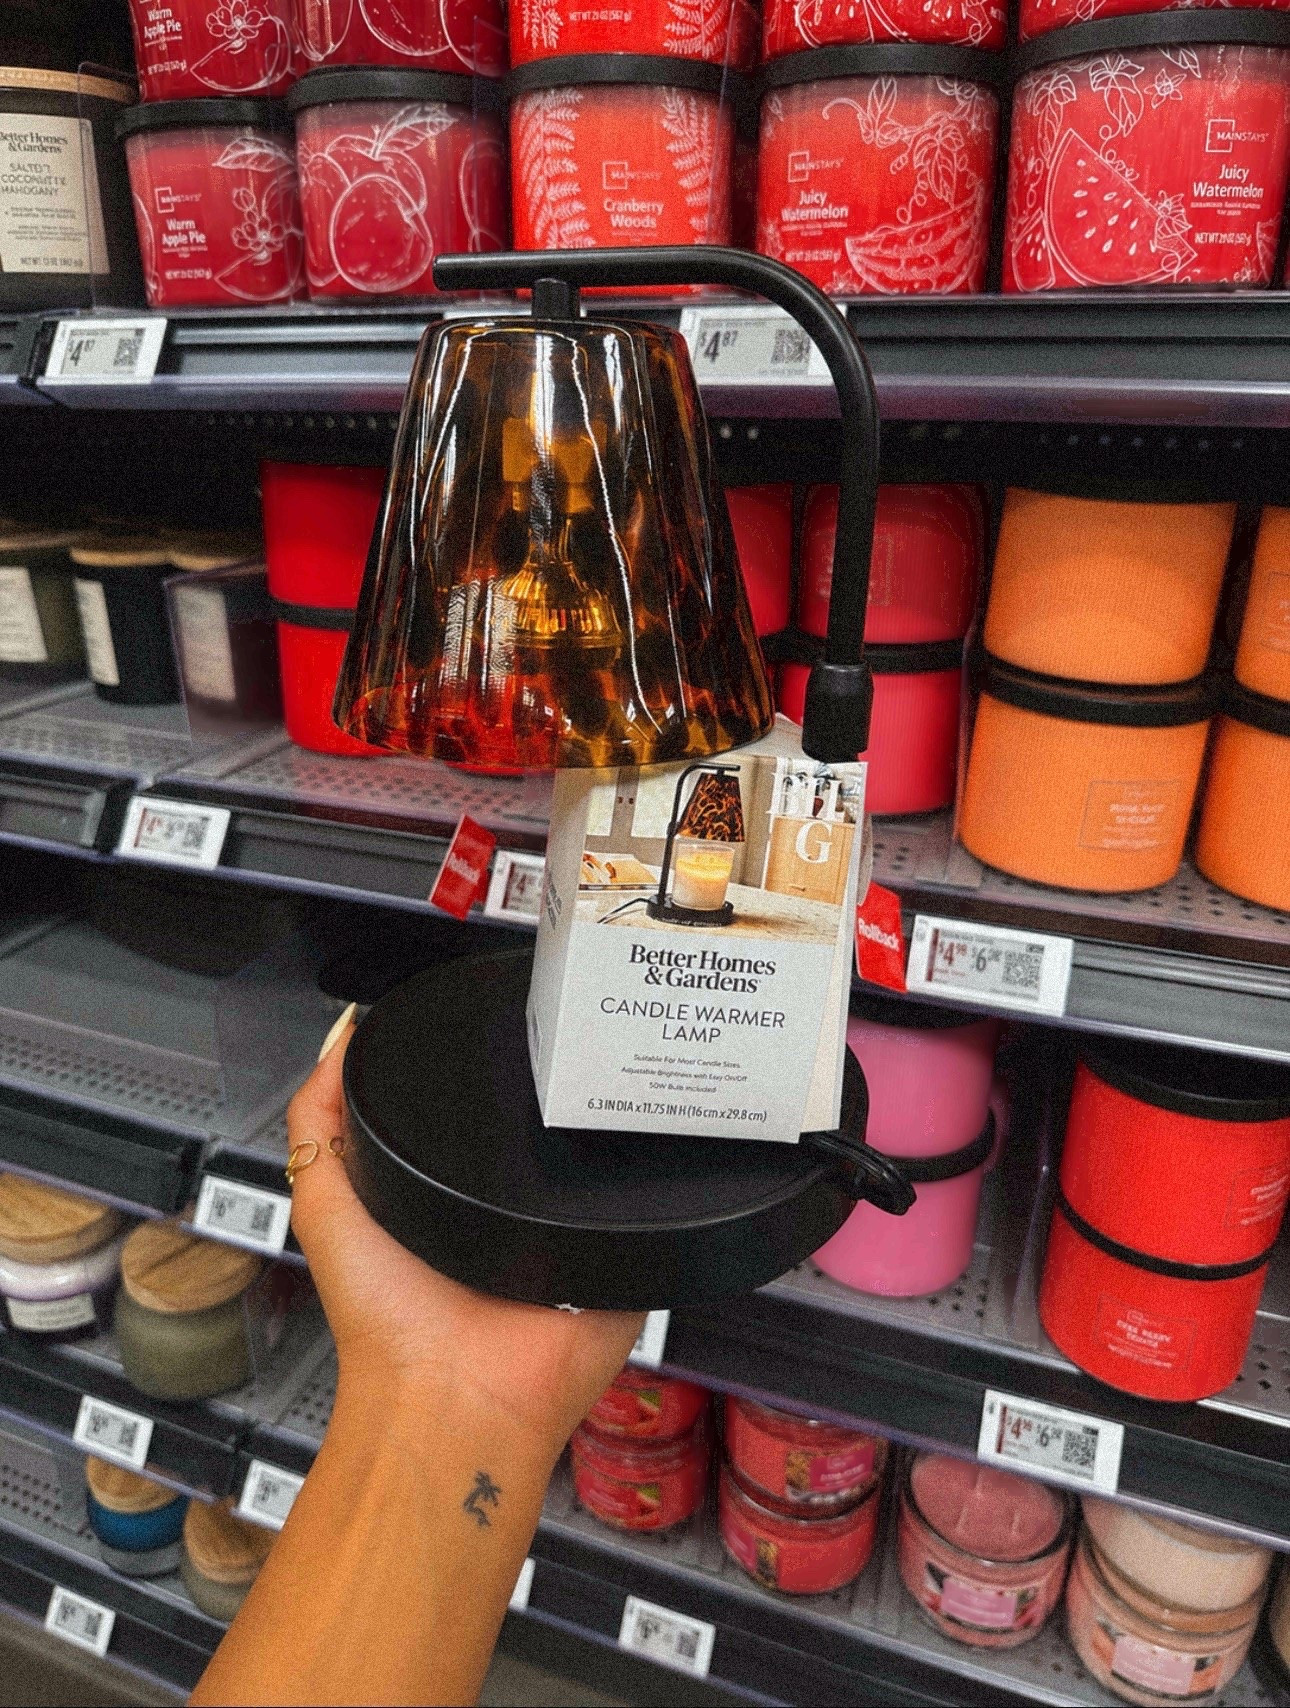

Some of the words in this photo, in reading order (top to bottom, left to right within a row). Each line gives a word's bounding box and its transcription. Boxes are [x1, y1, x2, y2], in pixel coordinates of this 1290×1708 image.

[147, 8, 172, 21] Warm
[144, 21, 166, 39] Apple
[166, 18, 182, 33] Pie
[29, 132, 68, 145] Homes
[1217, 132, 1266, 142] MAINSTAYS
[17, 143, 62, 154] Gardens
[1219, 164, 1249, 183] Juicy
[800, 189, 827, 207] Juicy
[1193, 181, 1264, 198] Watermelon
[603, 197, 664, 215] Cranberry
[782, 204, 849, 221] Watermelon
[166, 219, 196, 231] Warm
[610, 214, 657, 229] Woods
[162, 232, 188, 247] Apple
[189, 231, 206, 243] Pie
[795, 821, 833, 864] G
[858, 917, 899, 952] Rollback
[629, 944, 697, 968] Better
[700, 950, 776, 976] Homes
[644, 966, 662, 985] &
[665, 967, 759, 993] Gardens
[600, 997, 690, 1021] CANDLE
[695, 1004, 785, 1028] WARMER
[662, 1023, 721, 1043] LAMP
[633, 1054, 662, 1062] Suitable
[696, 1059, 721, 1067] Candle
[621, 1067, 656, 1075] Adjustable
[657, 1070, 692, 1078] Brightness
[649, 1081, 667, 1089] 50W
[587, 1098, 603, 1110] 6.3
[604, 1099, 615, 1111] IN
[616, 1100, 634, 1112] DIA
[643, 1102, 665, 1115] 11.75
[726, 1107, 748, 1120] 29.8
